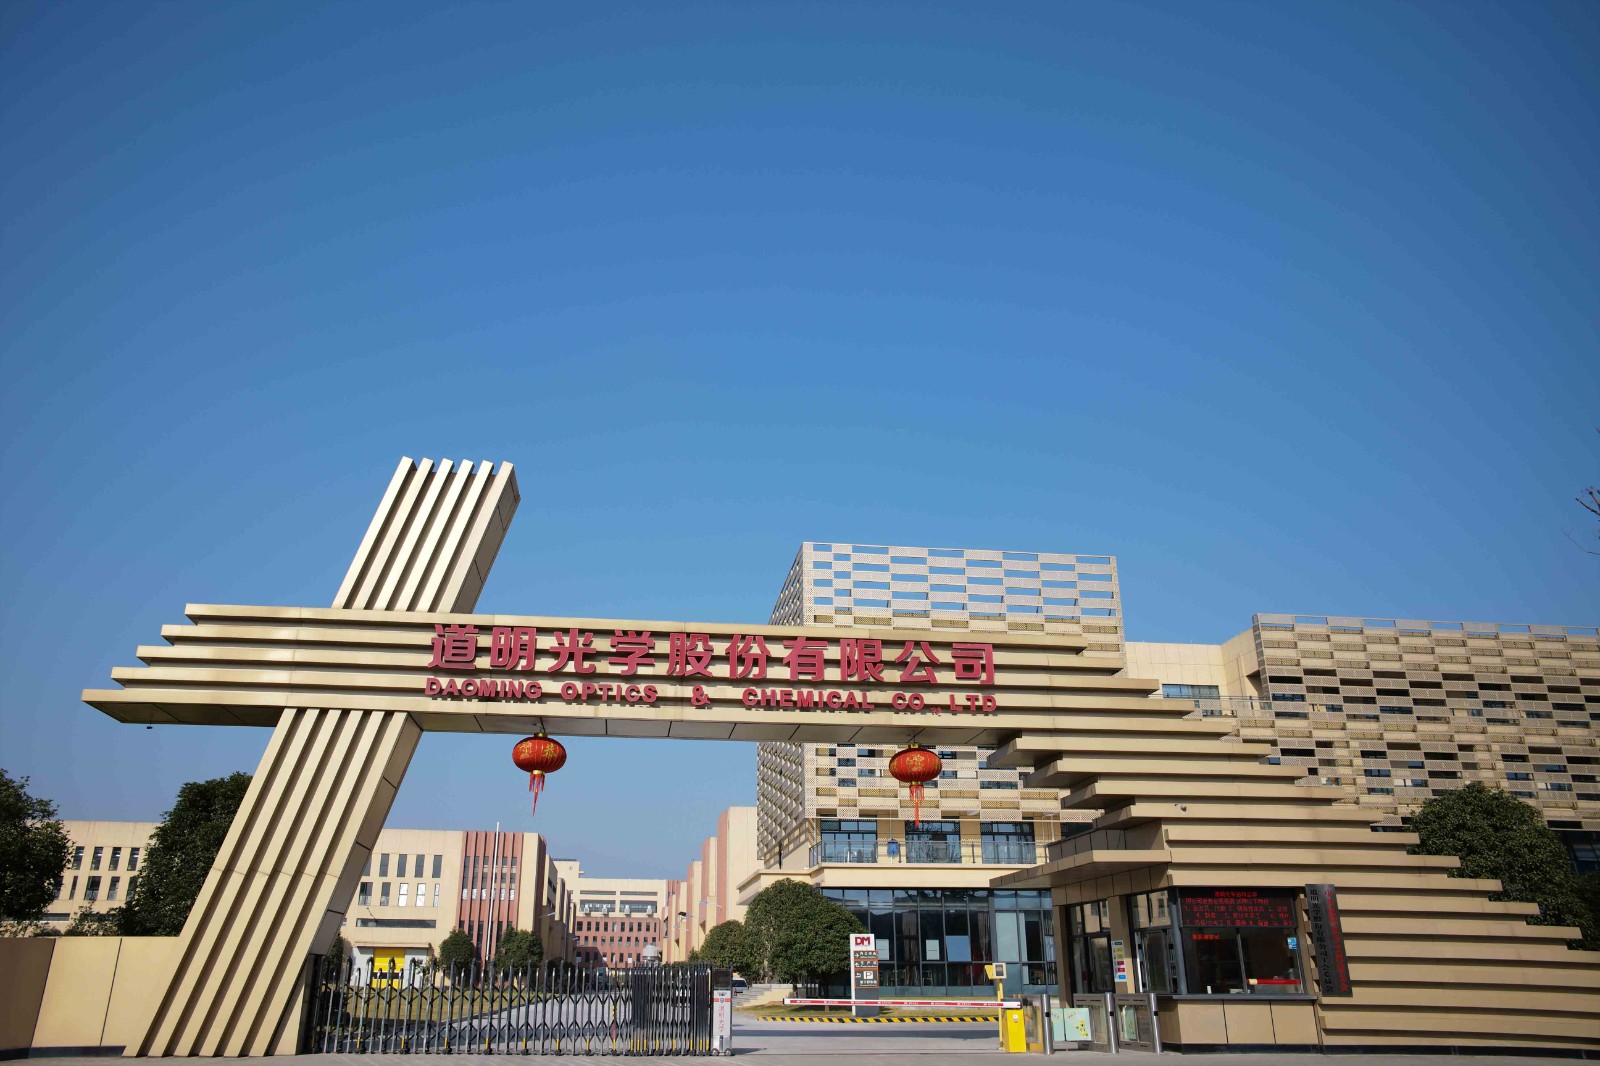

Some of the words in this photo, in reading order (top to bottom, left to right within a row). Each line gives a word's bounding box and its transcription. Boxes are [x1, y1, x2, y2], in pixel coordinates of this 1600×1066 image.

[428, 623, 996, 685] 道明光学股份有限公司
[425, 677, 542, 699] DAOMING
[561, 682, 658, 703] OPTICS
[690, 685, 711, 706] &
[742, 688, 875, 709] CHEMICAL
[855, 936, 870, 946] DM
